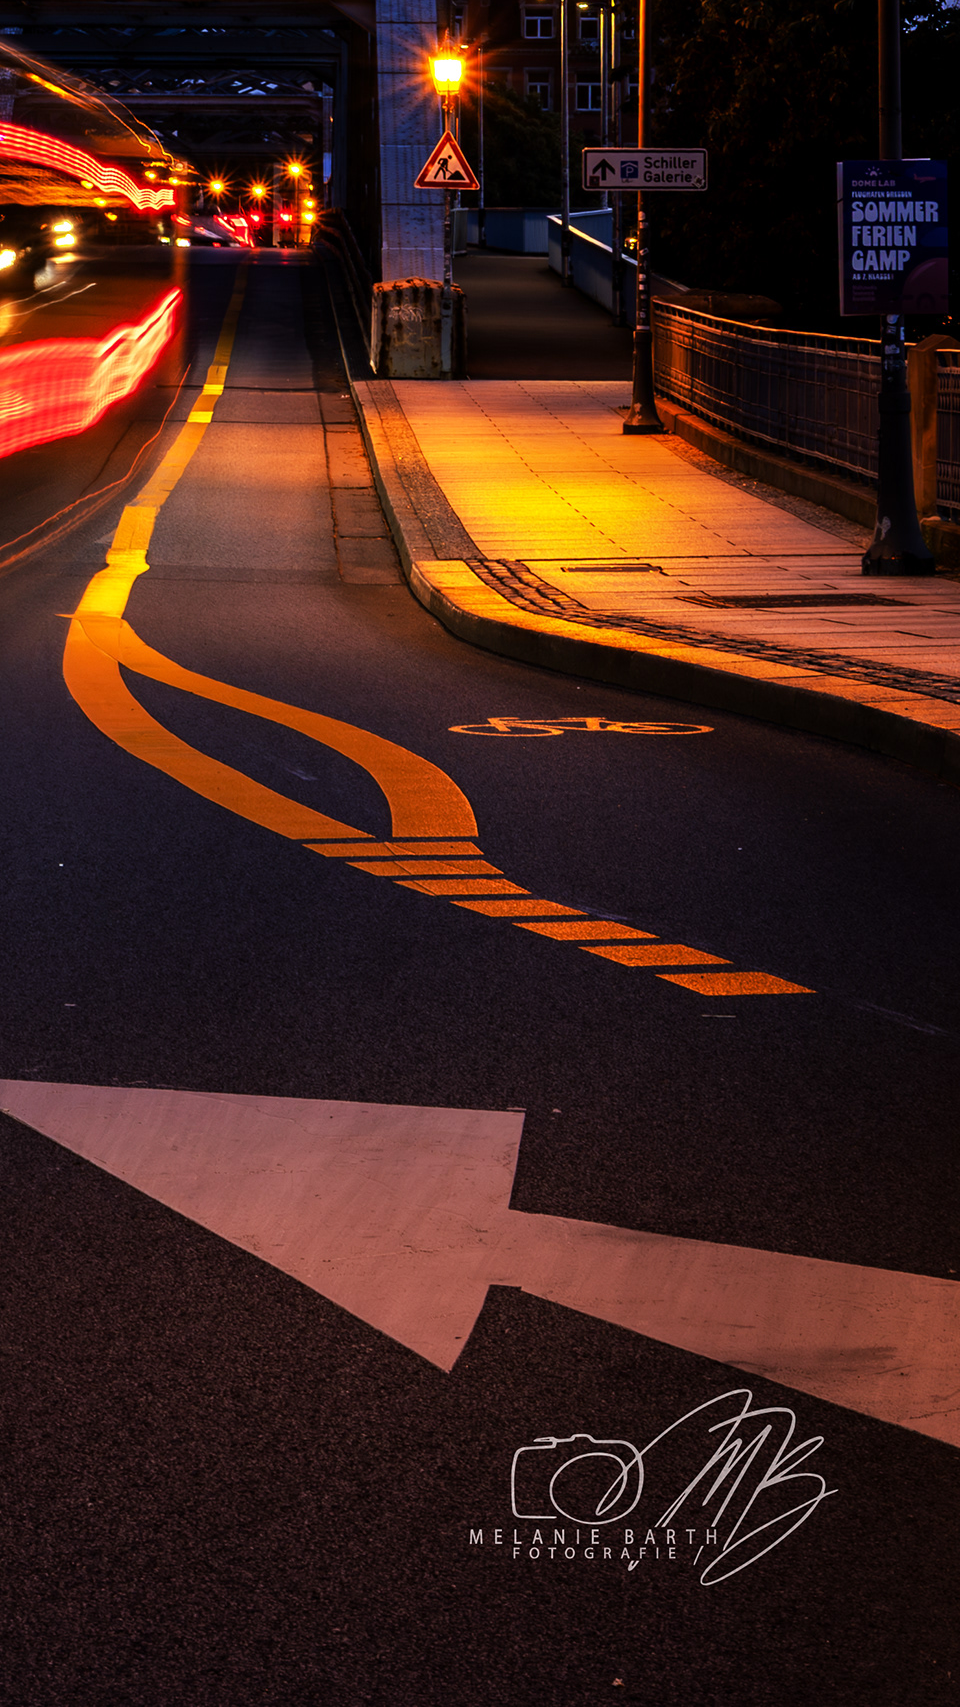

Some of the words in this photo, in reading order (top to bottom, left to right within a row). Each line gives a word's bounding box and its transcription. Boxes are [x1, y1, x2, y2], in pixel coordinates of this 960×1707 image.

[643, 156, 697, 170] Schiller
[643, 170, 693, 185] Galerie
[851, 179, 877, 188] DOME
[878, 179, 896, 188] LAB
[851, 200, 939, 223] SOMMER
[851, 225, 917, 247] FERIEN
[851, 249, 911, 271] CAMP
